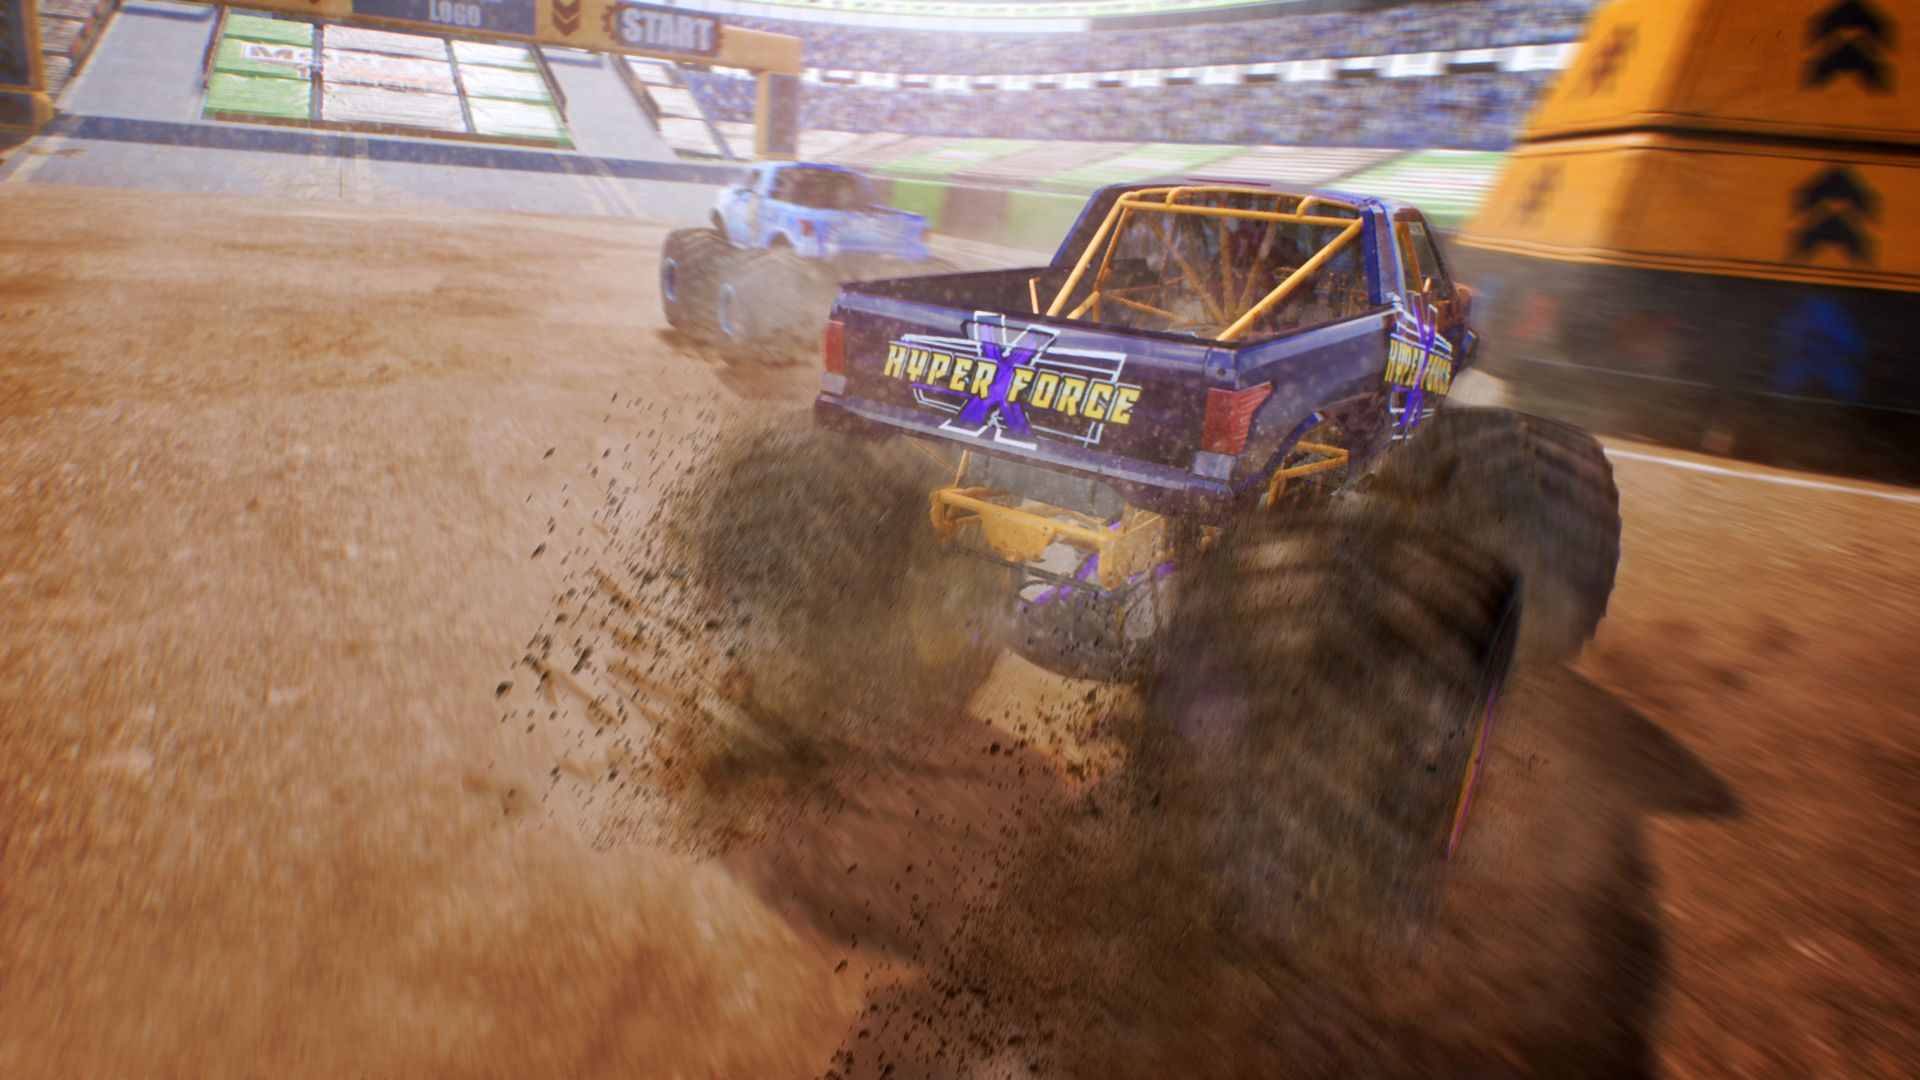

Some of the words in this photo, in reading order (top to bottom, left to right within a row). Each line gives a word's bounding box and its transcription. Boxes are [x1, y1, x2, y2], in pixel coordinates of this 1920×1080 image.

[431, 0, 481, 28] LOGO
[622, 9, 717, 51] START
[883, 345, 997, 399] HYPER
[1008, 366, 1142, 425] FORCE
